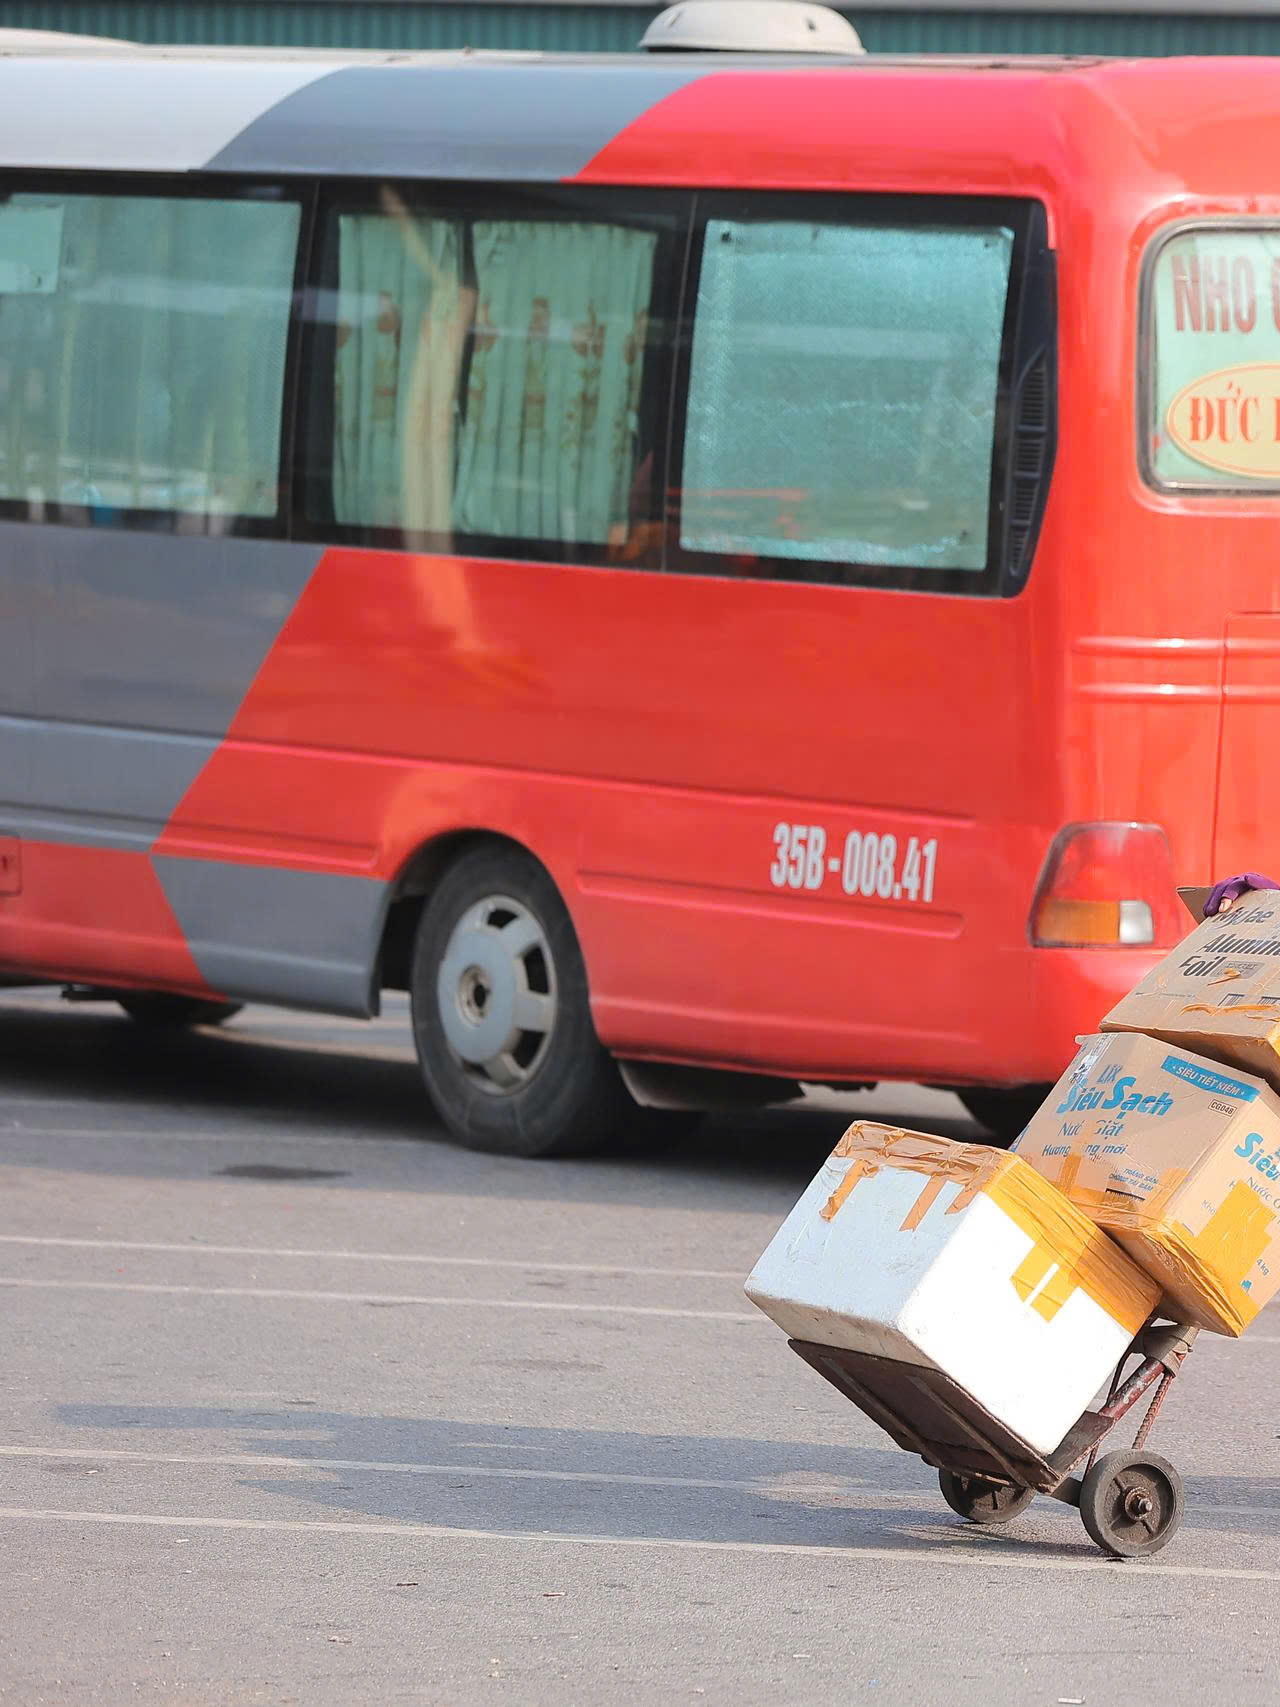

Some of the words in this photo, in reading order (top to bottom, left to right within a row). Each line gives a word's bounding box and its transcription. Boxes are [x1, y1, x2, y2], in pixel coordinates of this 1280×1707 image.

[1172, 255, 1256, 333] NHO
[1190, 380, 1259, 443] ĐỨC
[770, 822, 938, 903] 35B-008.41
[1179, 955, 1223, 977] Foil
[1177, 1066, 1199, 1080] SIÊU
[1056, 1077, 1104, 1113] Siêu
[1101, 1076, 1174, 1119] Sạch
[1210, 1101, 1234, 1115] CG048
[1247, 1176, 1272, 1200] Nước
